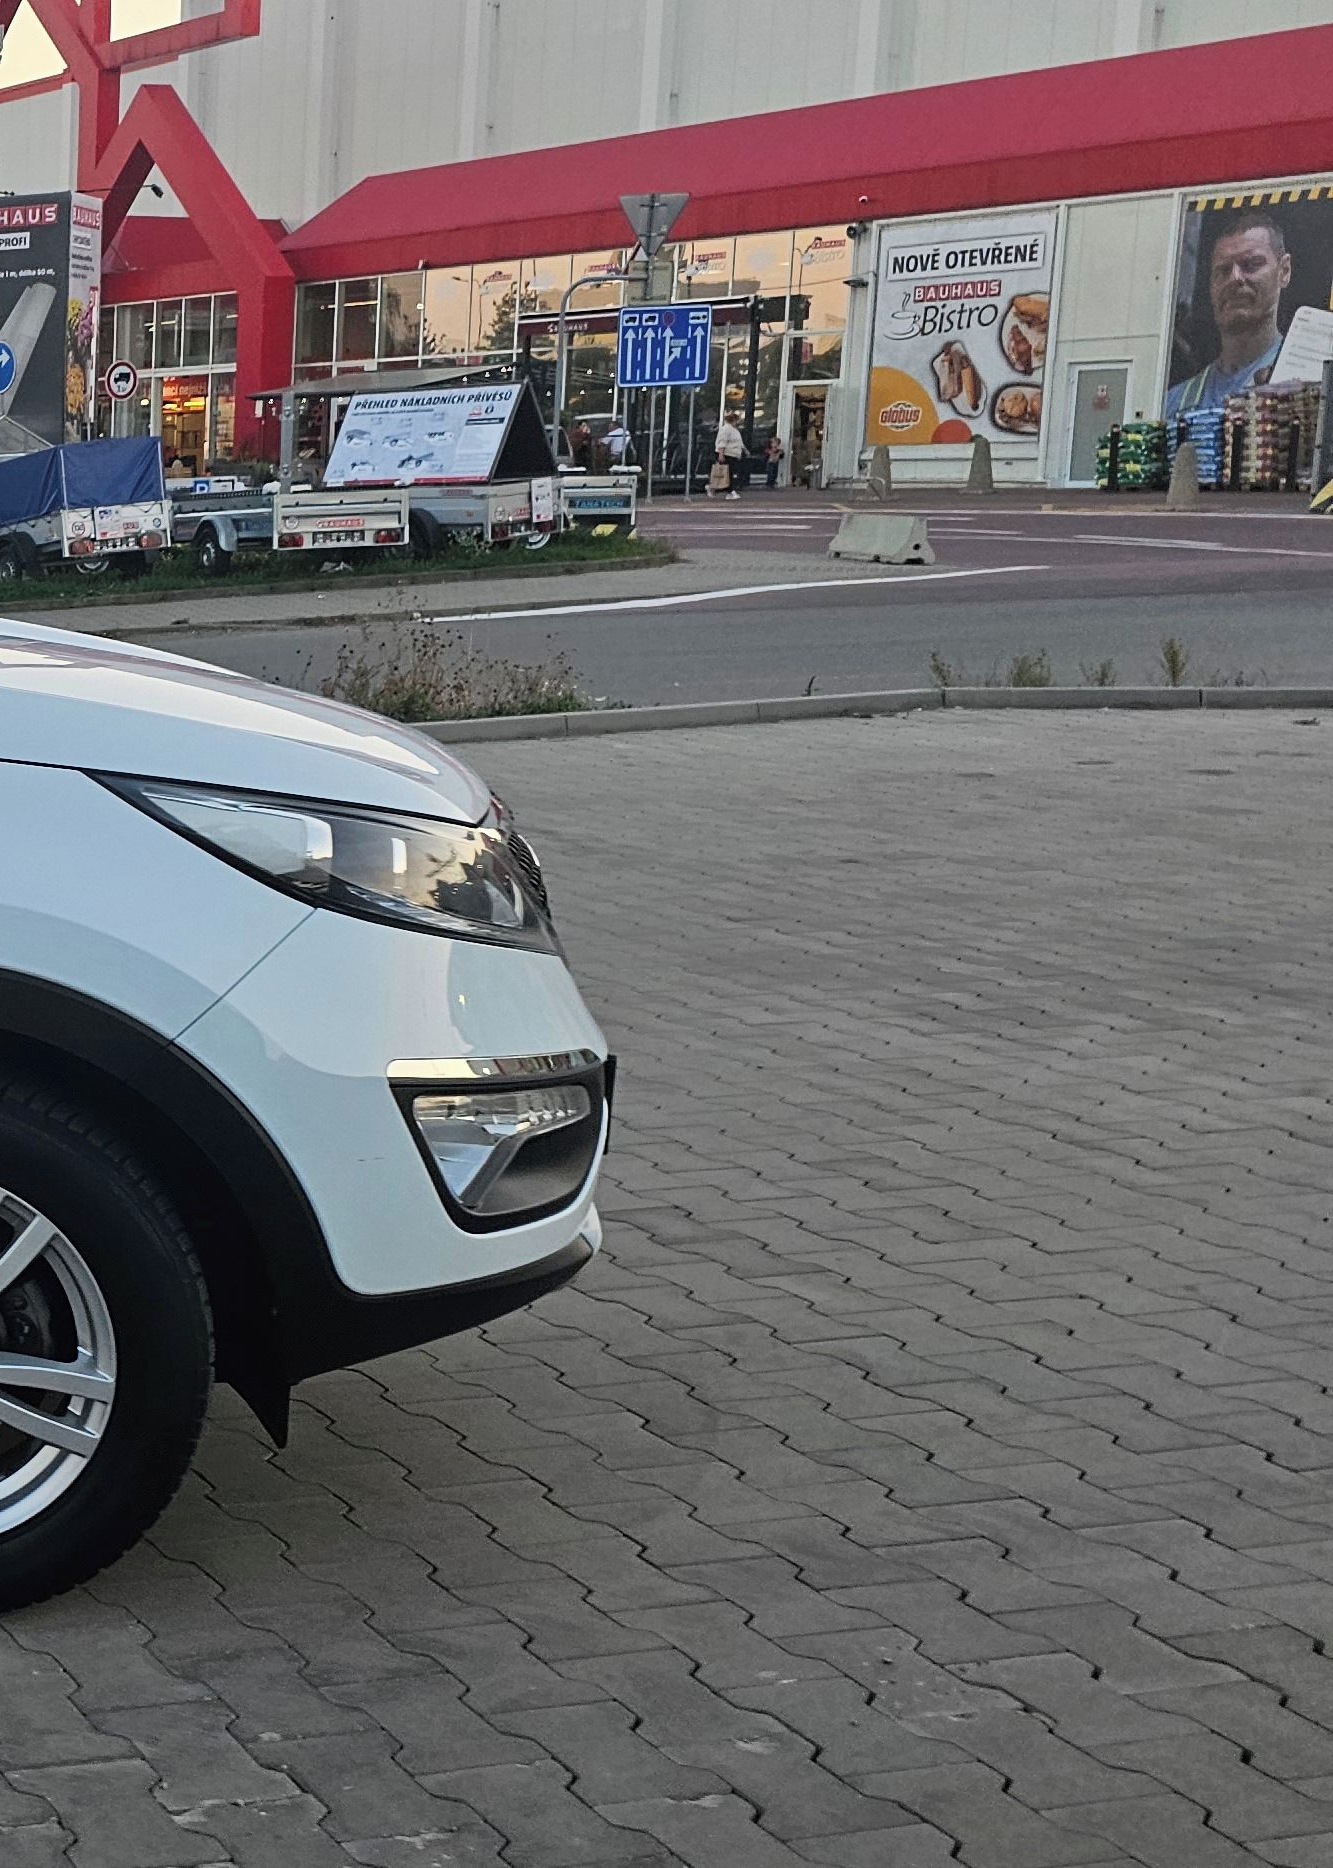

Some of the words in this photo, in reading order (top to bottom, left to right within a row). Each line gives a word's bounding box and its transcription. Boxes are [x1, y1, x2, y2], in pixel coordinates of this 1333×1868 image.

[945, 239, 1040, 269] OTEVŘENÉ
[915, 280, 1001, 300] BAUHAUS
[921, 303, 999, 337] Bistro
